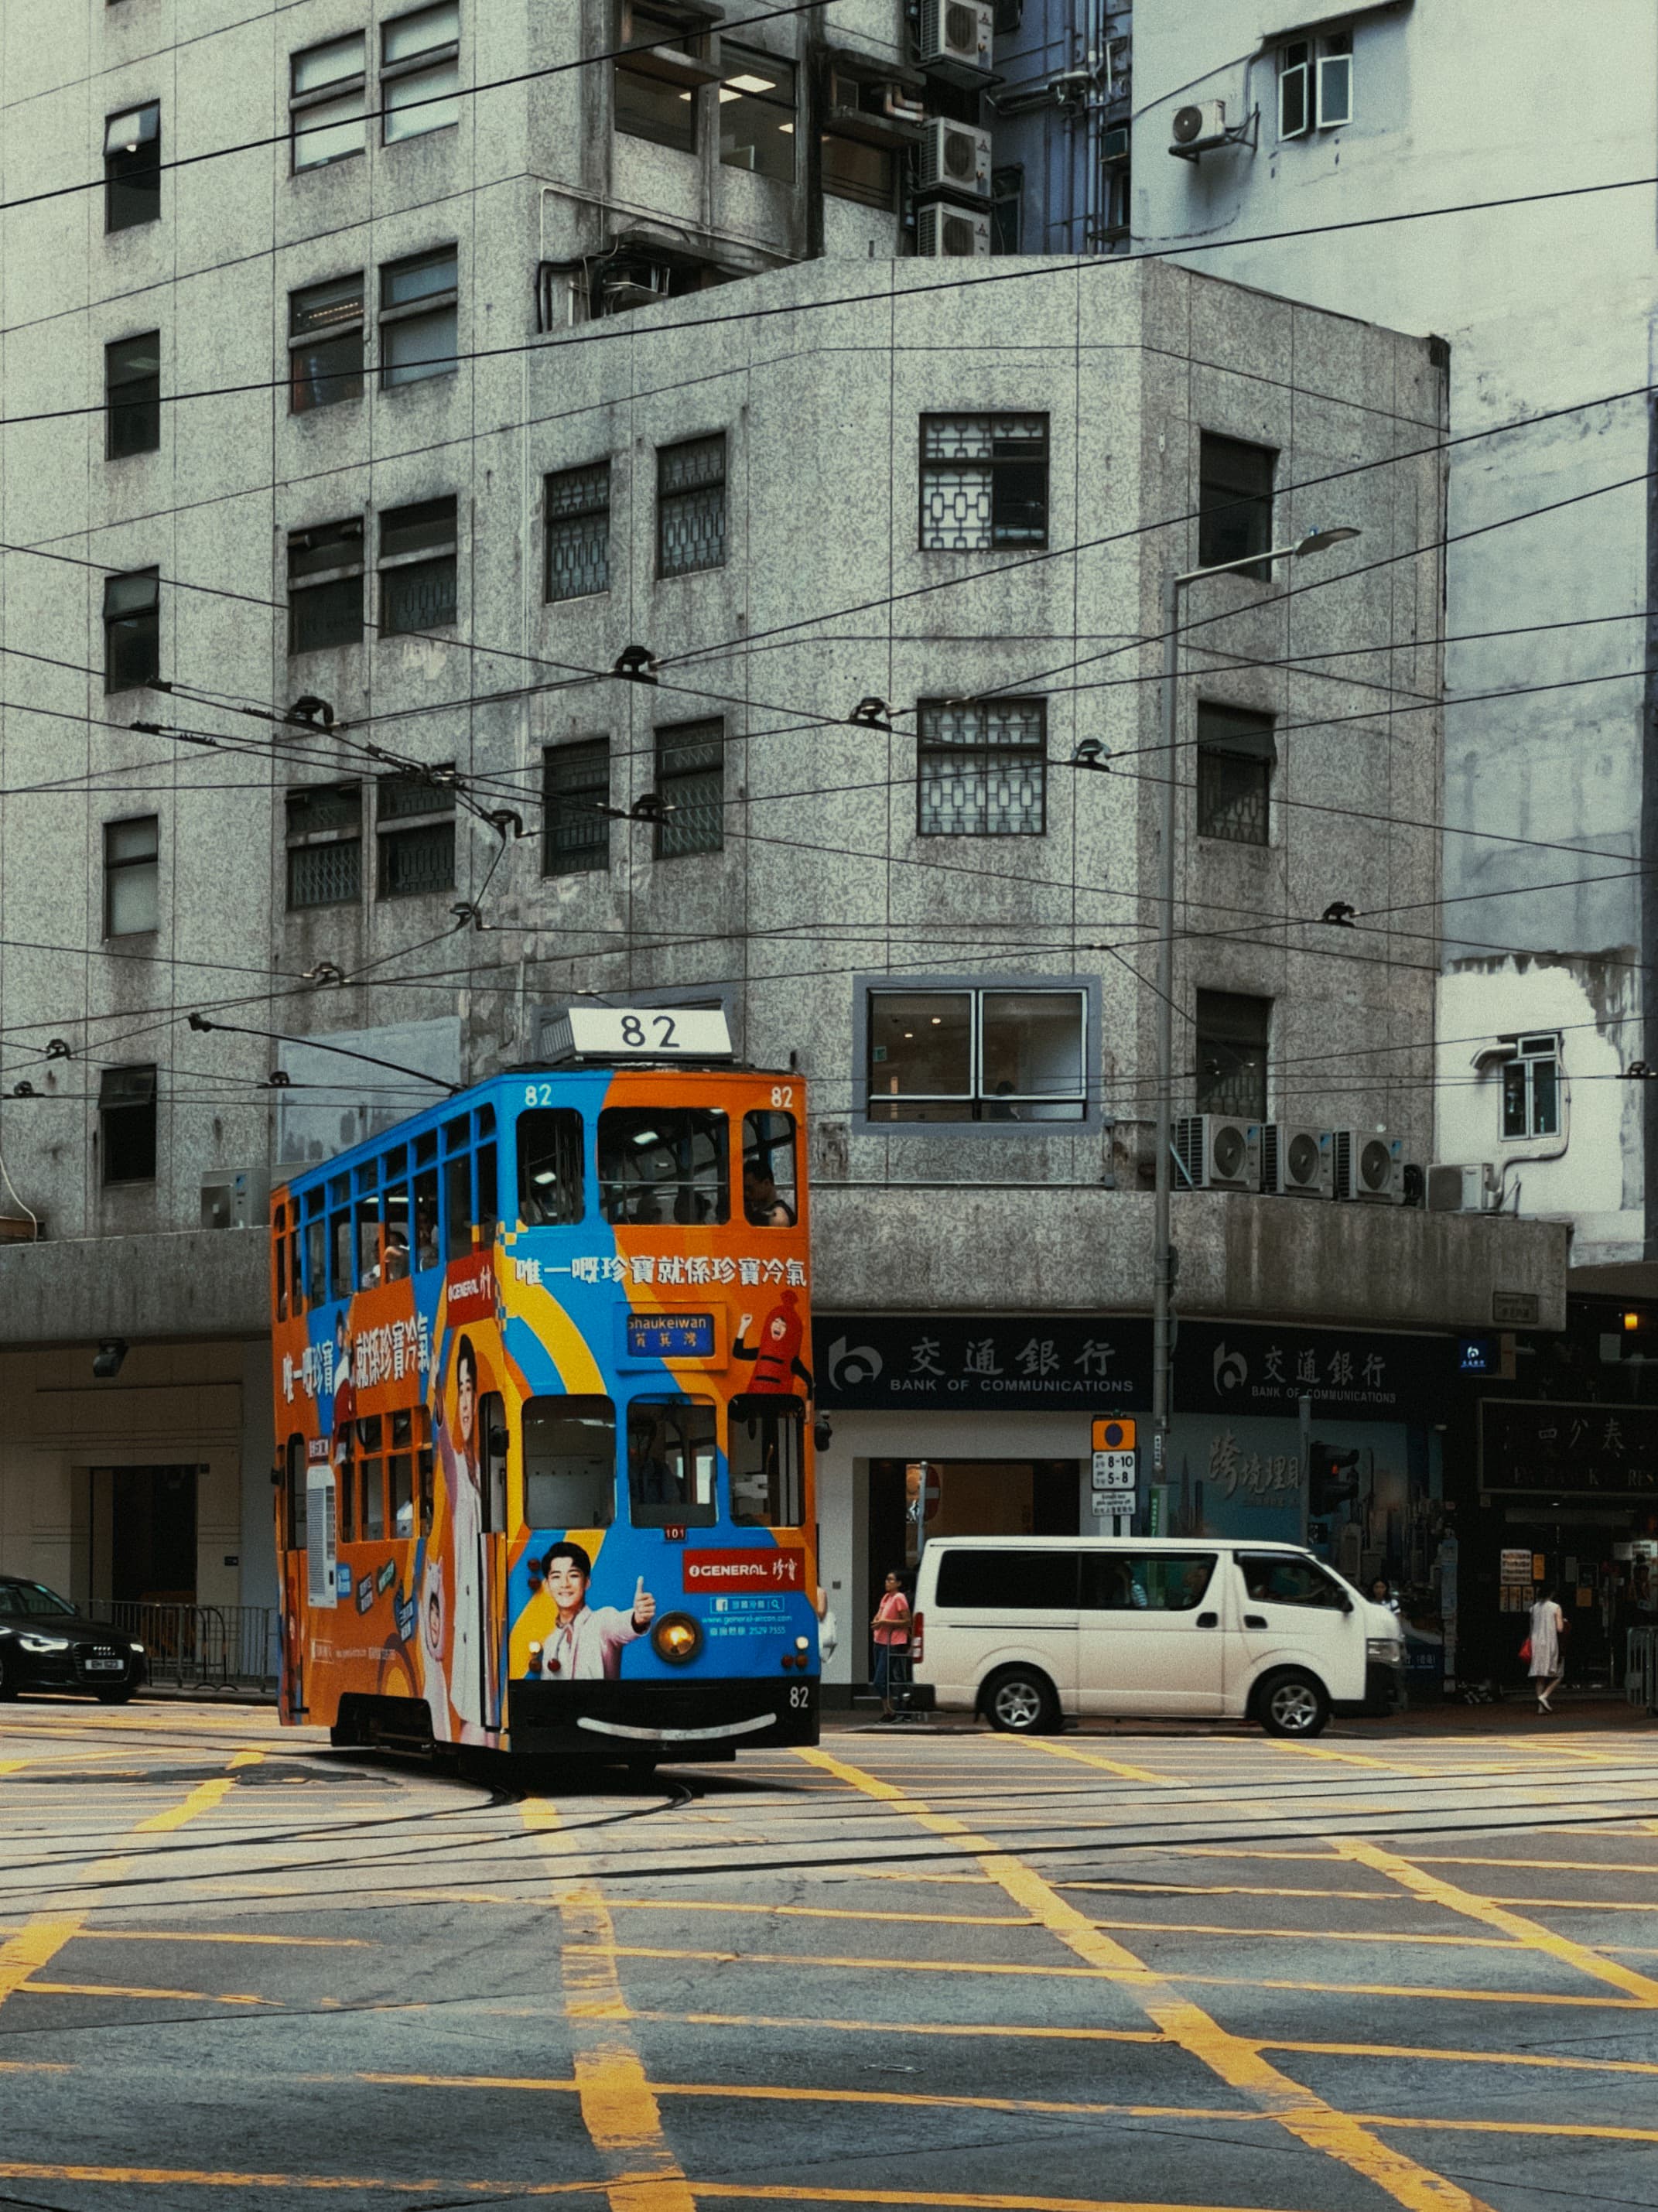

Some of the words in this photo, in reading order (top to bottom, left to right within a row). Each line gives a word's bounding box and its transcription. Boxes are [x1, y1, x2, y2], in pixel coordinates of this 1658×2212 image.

[621, 1015, 680, 1048] 82
[525, 1083, 552, 1107] 82
[771, 1085, 792, 1109] 82
[515, 1256, 808, 1287] 唯一嘅珍寶就係珍寶冷氣
[909, 1336, 1116, 1376] 交通銀行
[1263, 1345, 1386, 1387] 交通銀行
[891, 1379, 937, 1391] BANK
[947, 1379, 970, 1391] OF
[980, 1379, 1133, 1392] COMMUNICATIONS
[1252, 1385, 1280, 1398] BANK
[1287, 1386, 1301, 1399] OF
[1307, 1388, 1396, 1403] COMMUNICATIONS
[1108, 1455, 1133, 1468] 8-10
[666, 1528, 685, 1539] 101
[701, 1565, 767, 1576] GENERAL
[790, 1686, 809, 1708] 82
